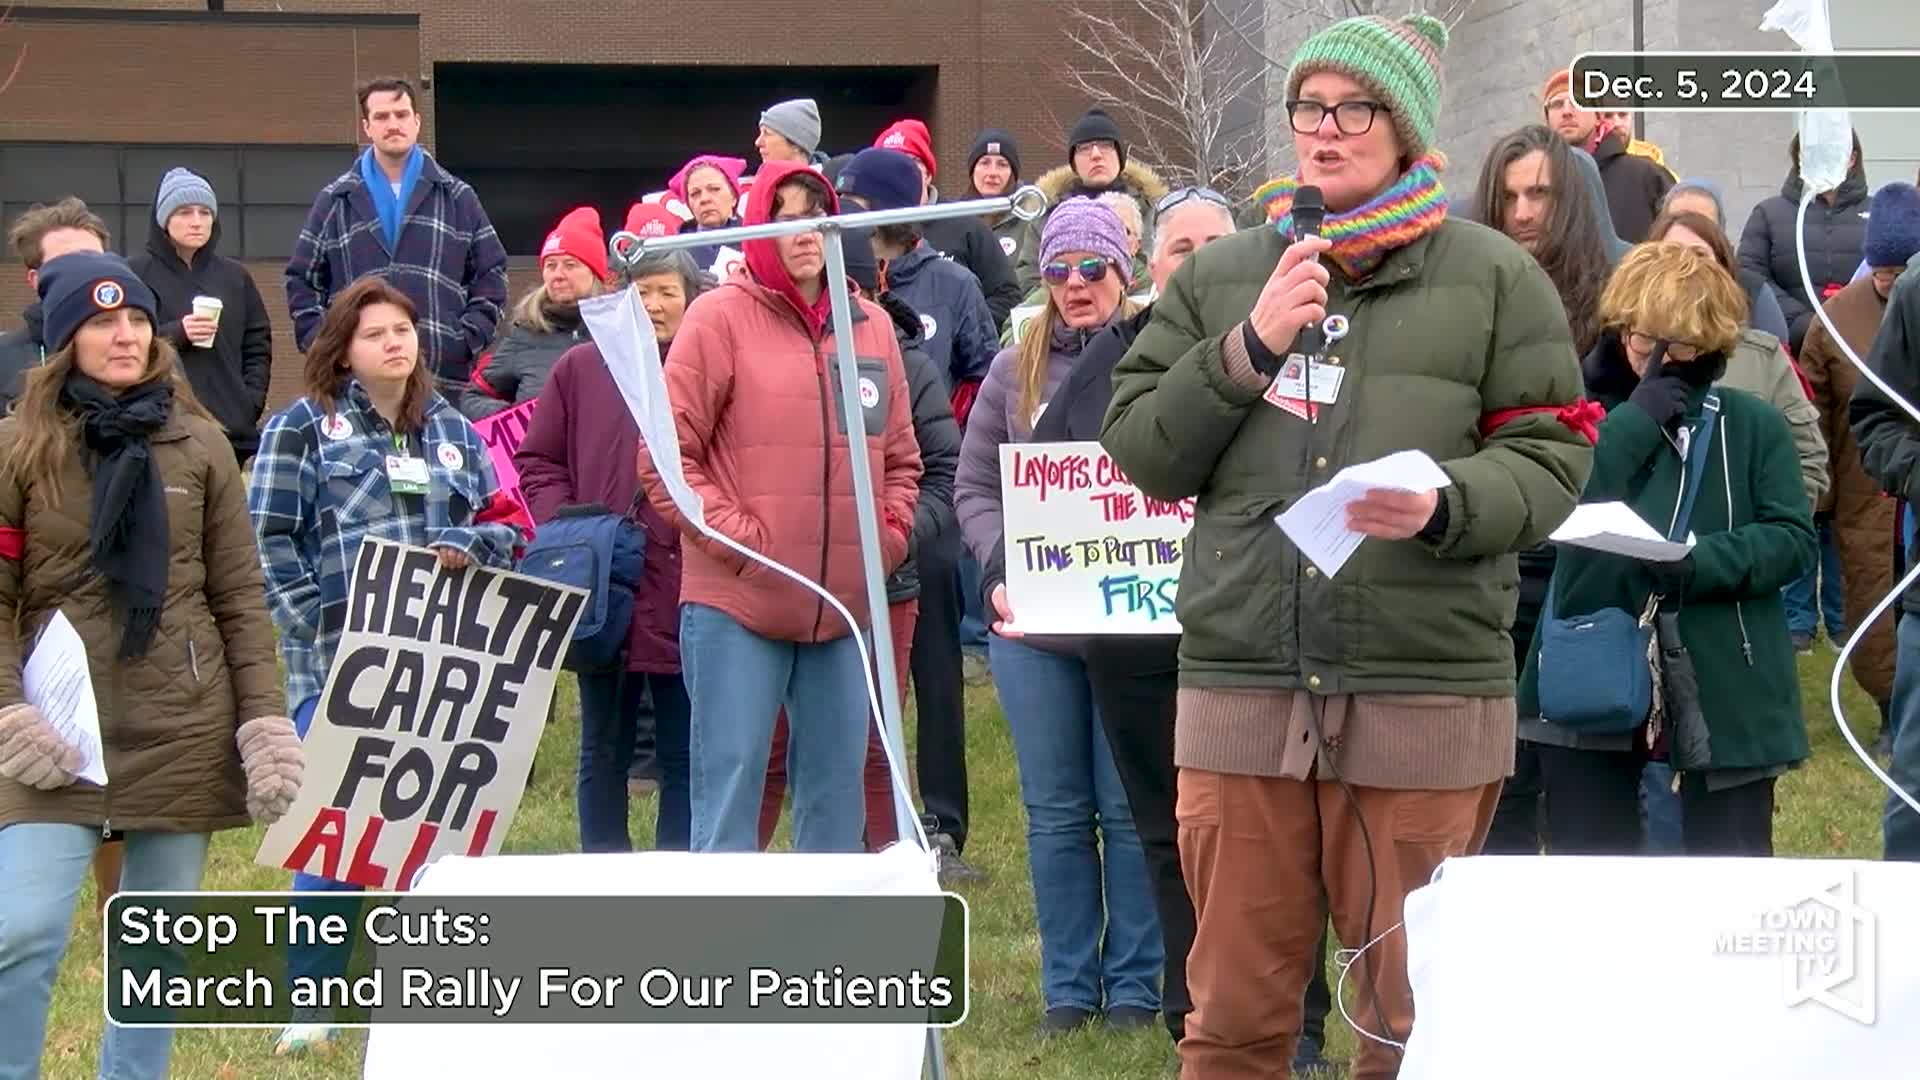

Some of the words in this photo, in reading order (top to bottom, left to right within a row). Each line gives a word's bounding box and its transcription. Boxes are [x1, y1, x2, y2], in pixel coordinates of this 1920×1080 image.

[1014, 452, 1092, 501] LAYOFFS,
[1096, 455, 1133, 487] CU
[1090, 492, 1137, 522] THE
[1144, 496, 1196, 523] WORS
[1017, 536, 1074, 572] TIME
[1076, 540, 1100, 568] TO
[1103, 537, 1141, 566] PUT
[1142, 538, 1182, 566] THE
[349, 541, 587, 671] HEALTH
[1099, 575, 1180, 621] FIRS
[327, 646, 529, 744] CARE
[331, 737, 499, 832] FOR
